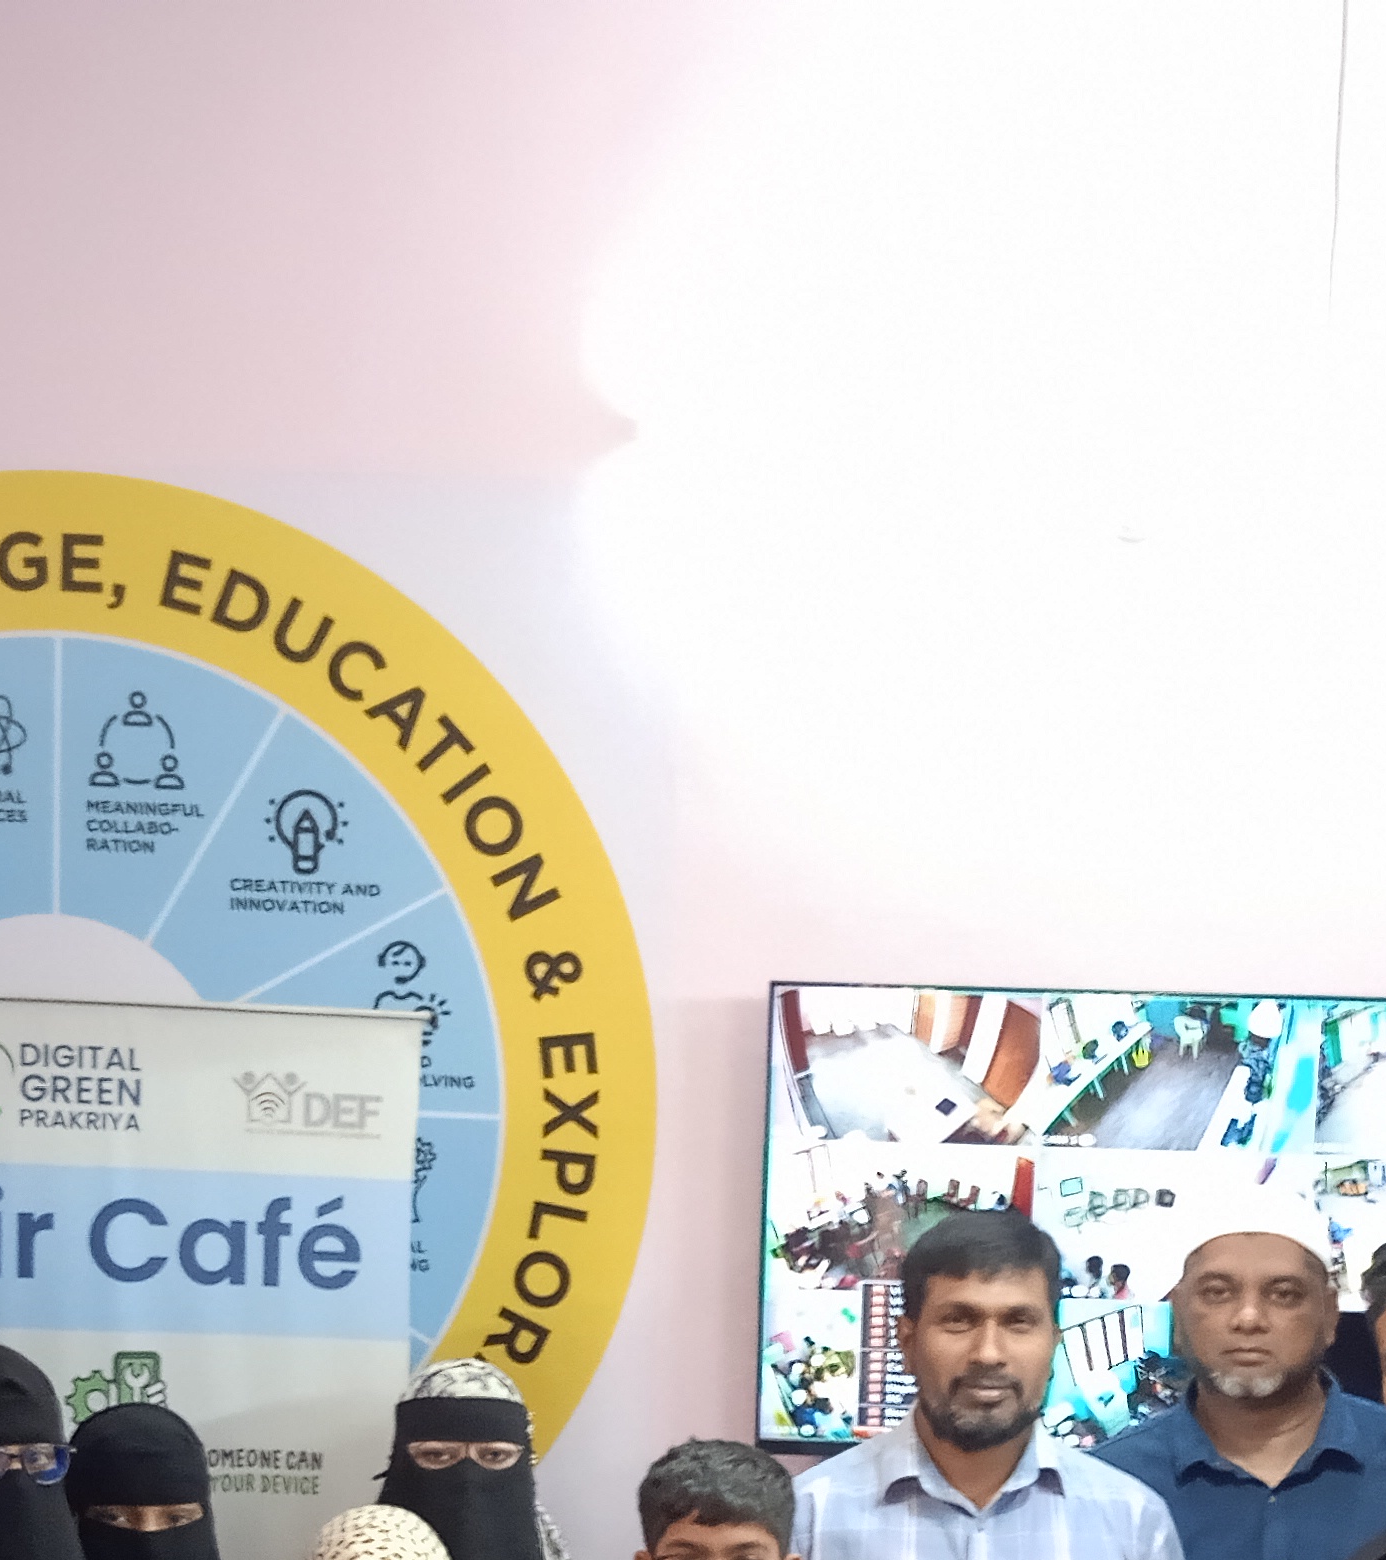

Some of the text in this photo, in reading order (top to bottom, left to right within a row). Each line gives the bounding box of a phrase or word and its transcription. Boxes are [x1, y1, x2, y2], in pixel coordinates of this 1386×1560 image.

[159, 549, 562, 923] EDUCATION
[86, 800, 205, 818] MEANINGFUL
[86, 819, 179, 835] COLLABO-
[86, 838, 155, 854] RATION
[229, 877, 381, 897] CREATIVITY AND
[229, 897, 345, 915] INNOVATION
[523, 950, 584, 1001] &
[20, 1042, 142, 1072] DIGITAL
[20, 1074, 142, 1107] GREEN
[420, 1073, 475, 1089] LVING
[20, 1108, 142, 1132] PRAKRIYA
[302, 1092, 383, 1131] DEF
[473, 1032, 600, 1366] EXPLOR
[89, 1196, 362, 1290] Café
[206, 1448, 324, 1471] OMEONE CAN
[259, 1473, 320, 1495] DEVICE
